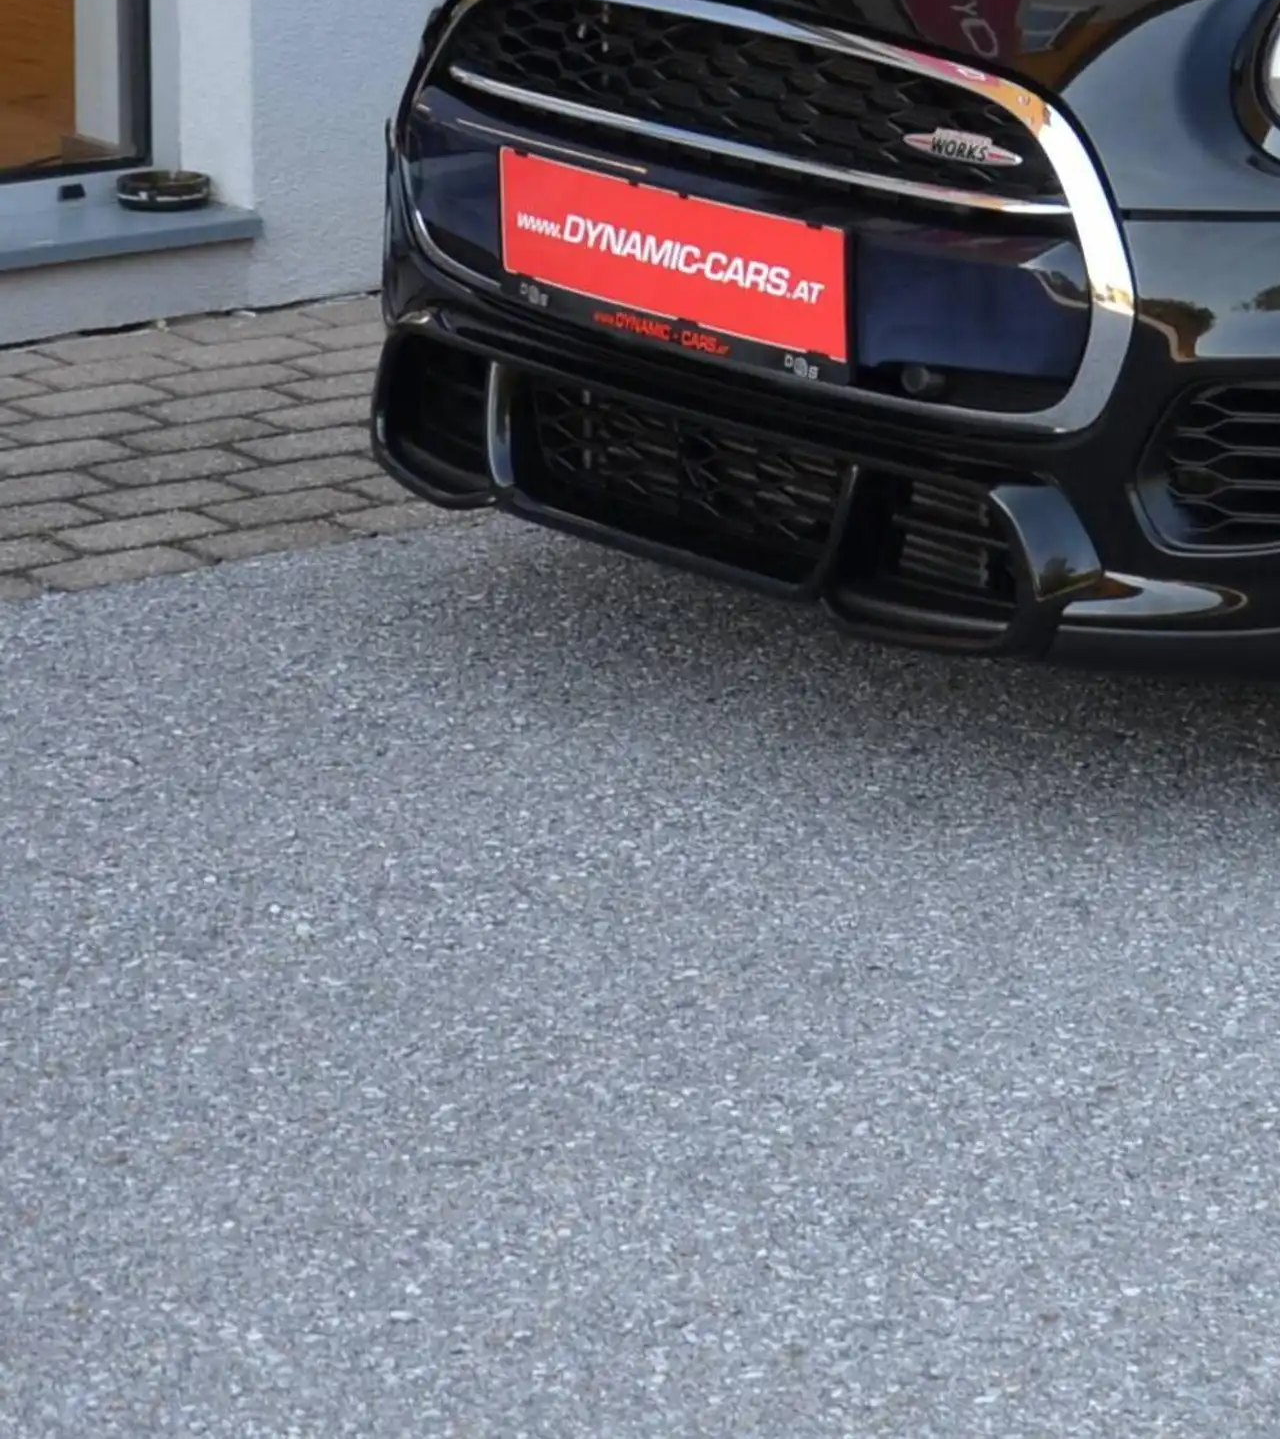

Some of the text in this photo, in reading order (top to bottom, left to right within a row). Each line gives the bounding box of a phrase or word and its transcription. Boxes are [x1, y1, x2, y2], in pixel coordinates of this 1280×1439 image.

[931, 137, 990, 162] WORKS
[516, 211, 825, 305] www.DYNAMIC-CARS.AT
[784, 353, 819, 380] DS
